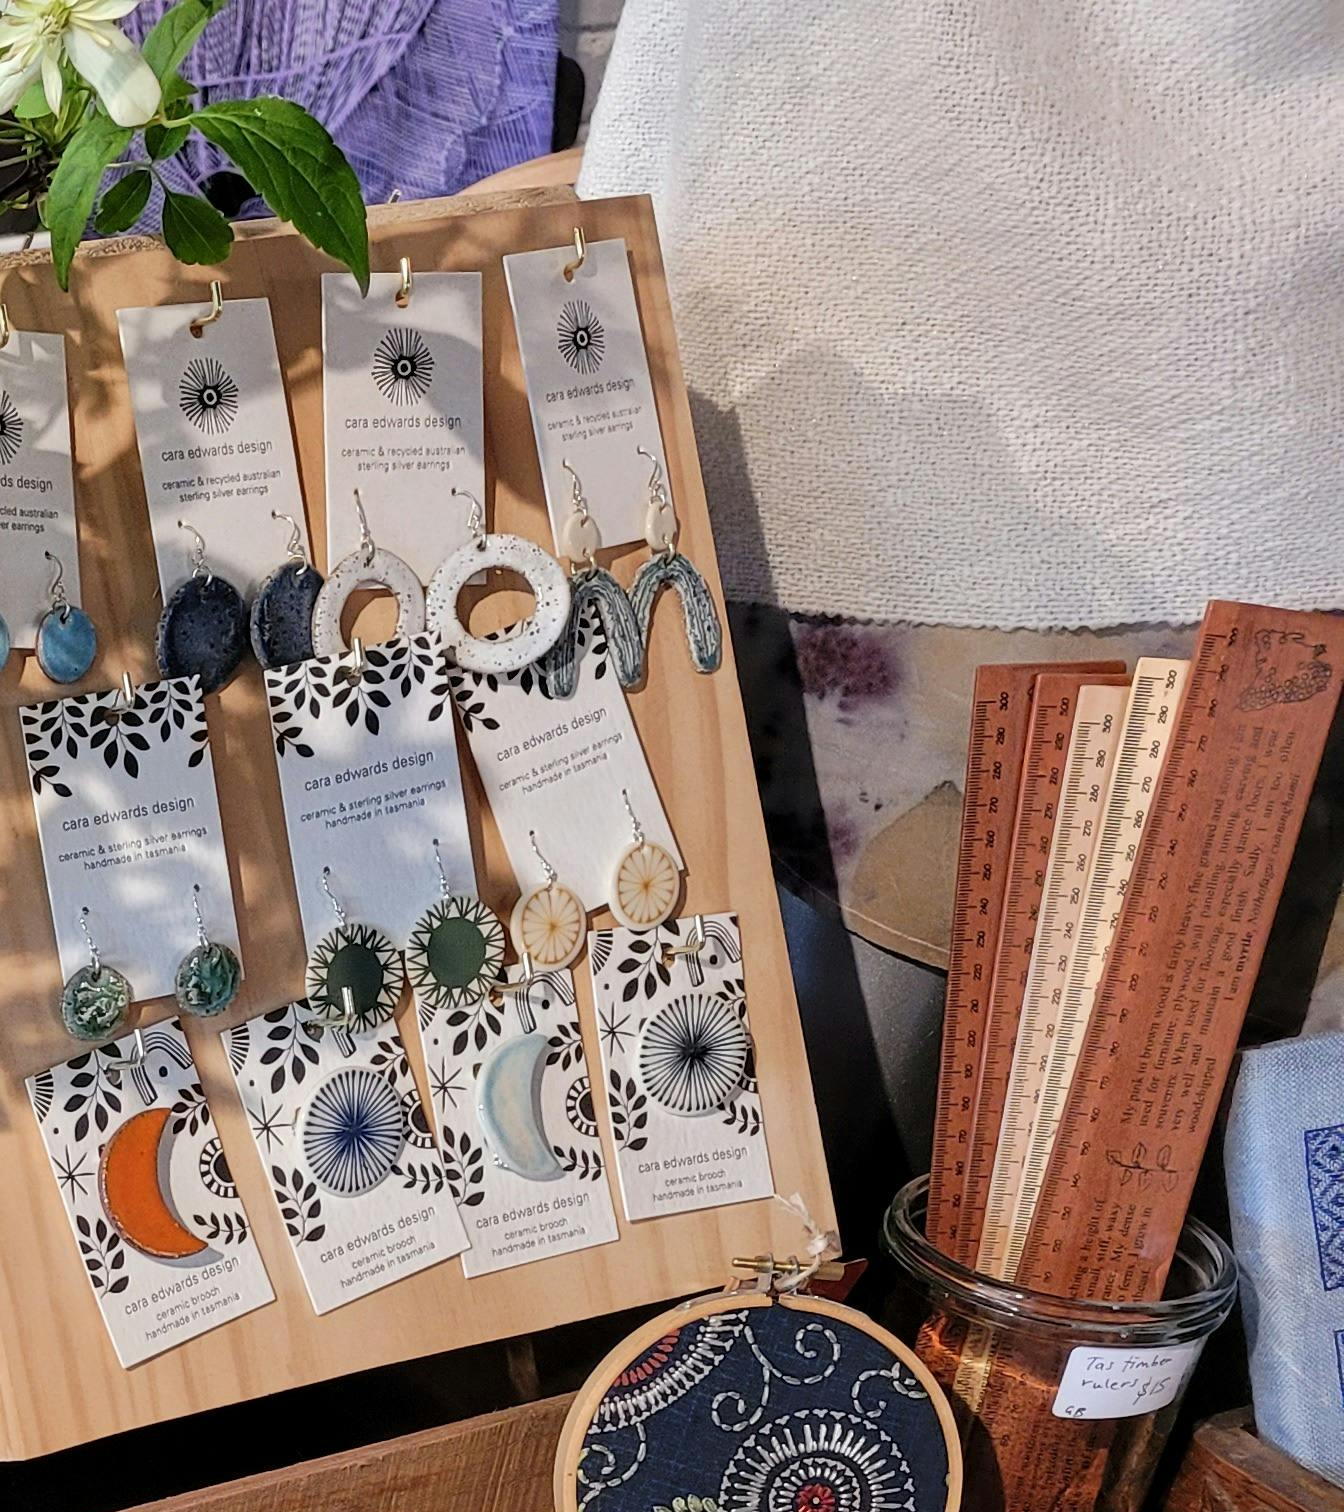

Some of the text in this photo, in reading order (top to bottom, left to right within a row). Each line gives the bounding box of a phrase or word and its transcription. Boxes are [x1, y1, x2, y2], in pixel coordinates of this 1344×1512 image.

[344, 414, 462, 431] cara edwards design
[161, 440, 273, 463] cara edwards design
[16, 475, 53, 494] design
[496, 707, 607, 762] cara edwards design
[304, 751, 434, 792] cara edwards design
[1141, 776, 1153, 794] 270
[62, 797, 195, 832] cara edwards design
[300, 779, 447, 823] ceramic & sterling silver earrings
[324, 796, 426, 830] handmade in tasmania
[1082, 820, 1094, 837] 270
[1187, 1057, 1217, 1135] woodchipped
[637, 1146, 748, 1174] cara edwards design
[475, 1192, 590, 1230] cara edwards design
[319, 1206, 436, 1264] cara edwards design
[124, 1256, 240, 1316] cara edwards design
[144, 1292, 241, 1341] handmade in tasmania
[156, 1286, 221, 1322] ceramic brooch
[1086, 1355, 1173, 1372] Tas timber
[1081, 1377, 1171, 1405] rulers $15
